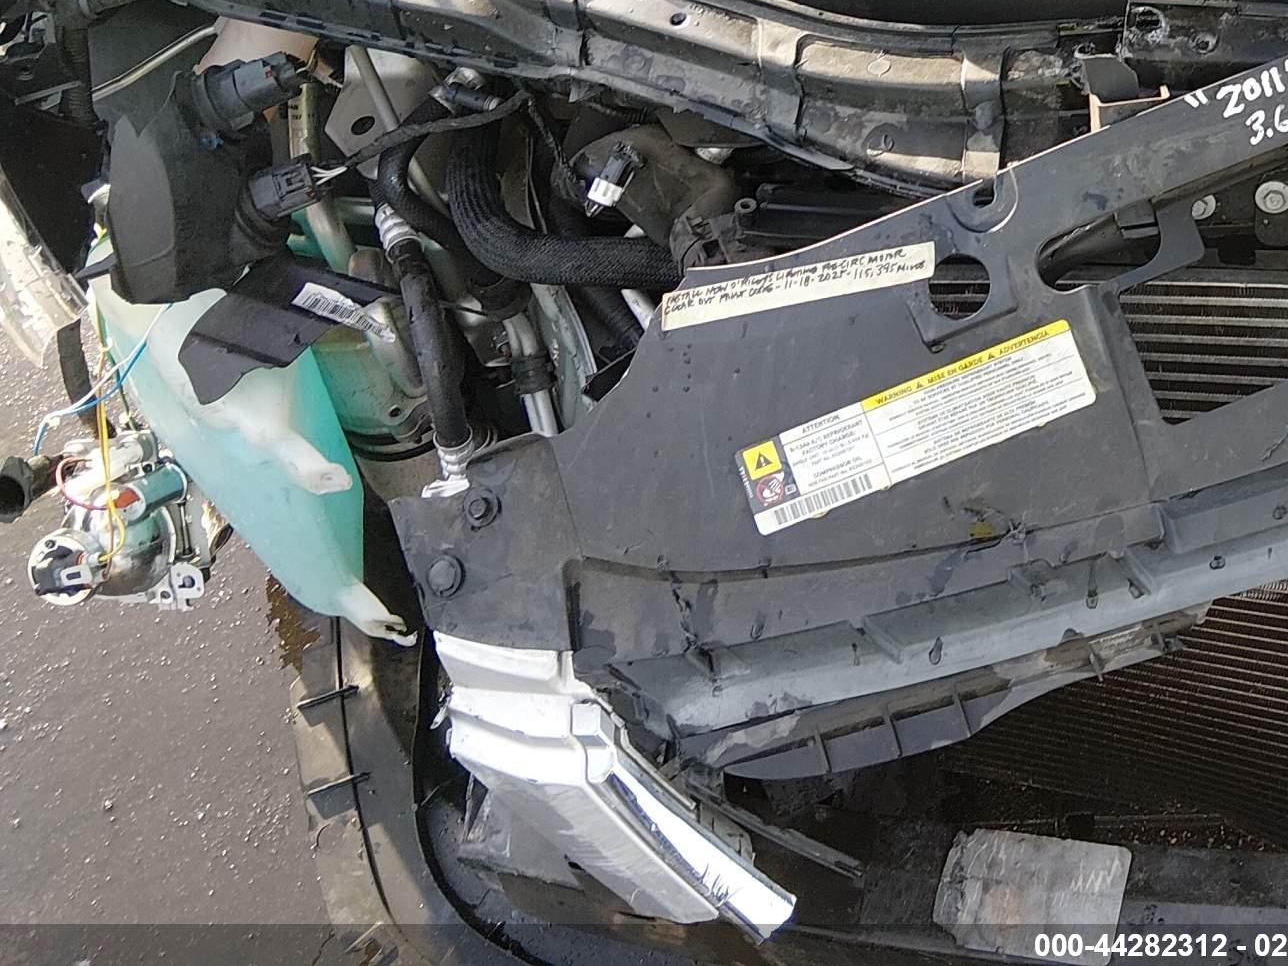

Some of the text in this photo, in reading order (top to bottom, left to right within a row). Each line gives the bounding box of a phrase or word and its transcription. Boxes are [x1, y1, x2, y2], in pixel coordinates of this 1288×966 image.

[874, 387, 913, 405] WARNING
[927, 372, 947, 385] MISE
[958, 356, 984, 372] GARDE
[999, 330, 1050, 356] ADVERTENCIA
[802, 414, 841, 434] ATTENTION
